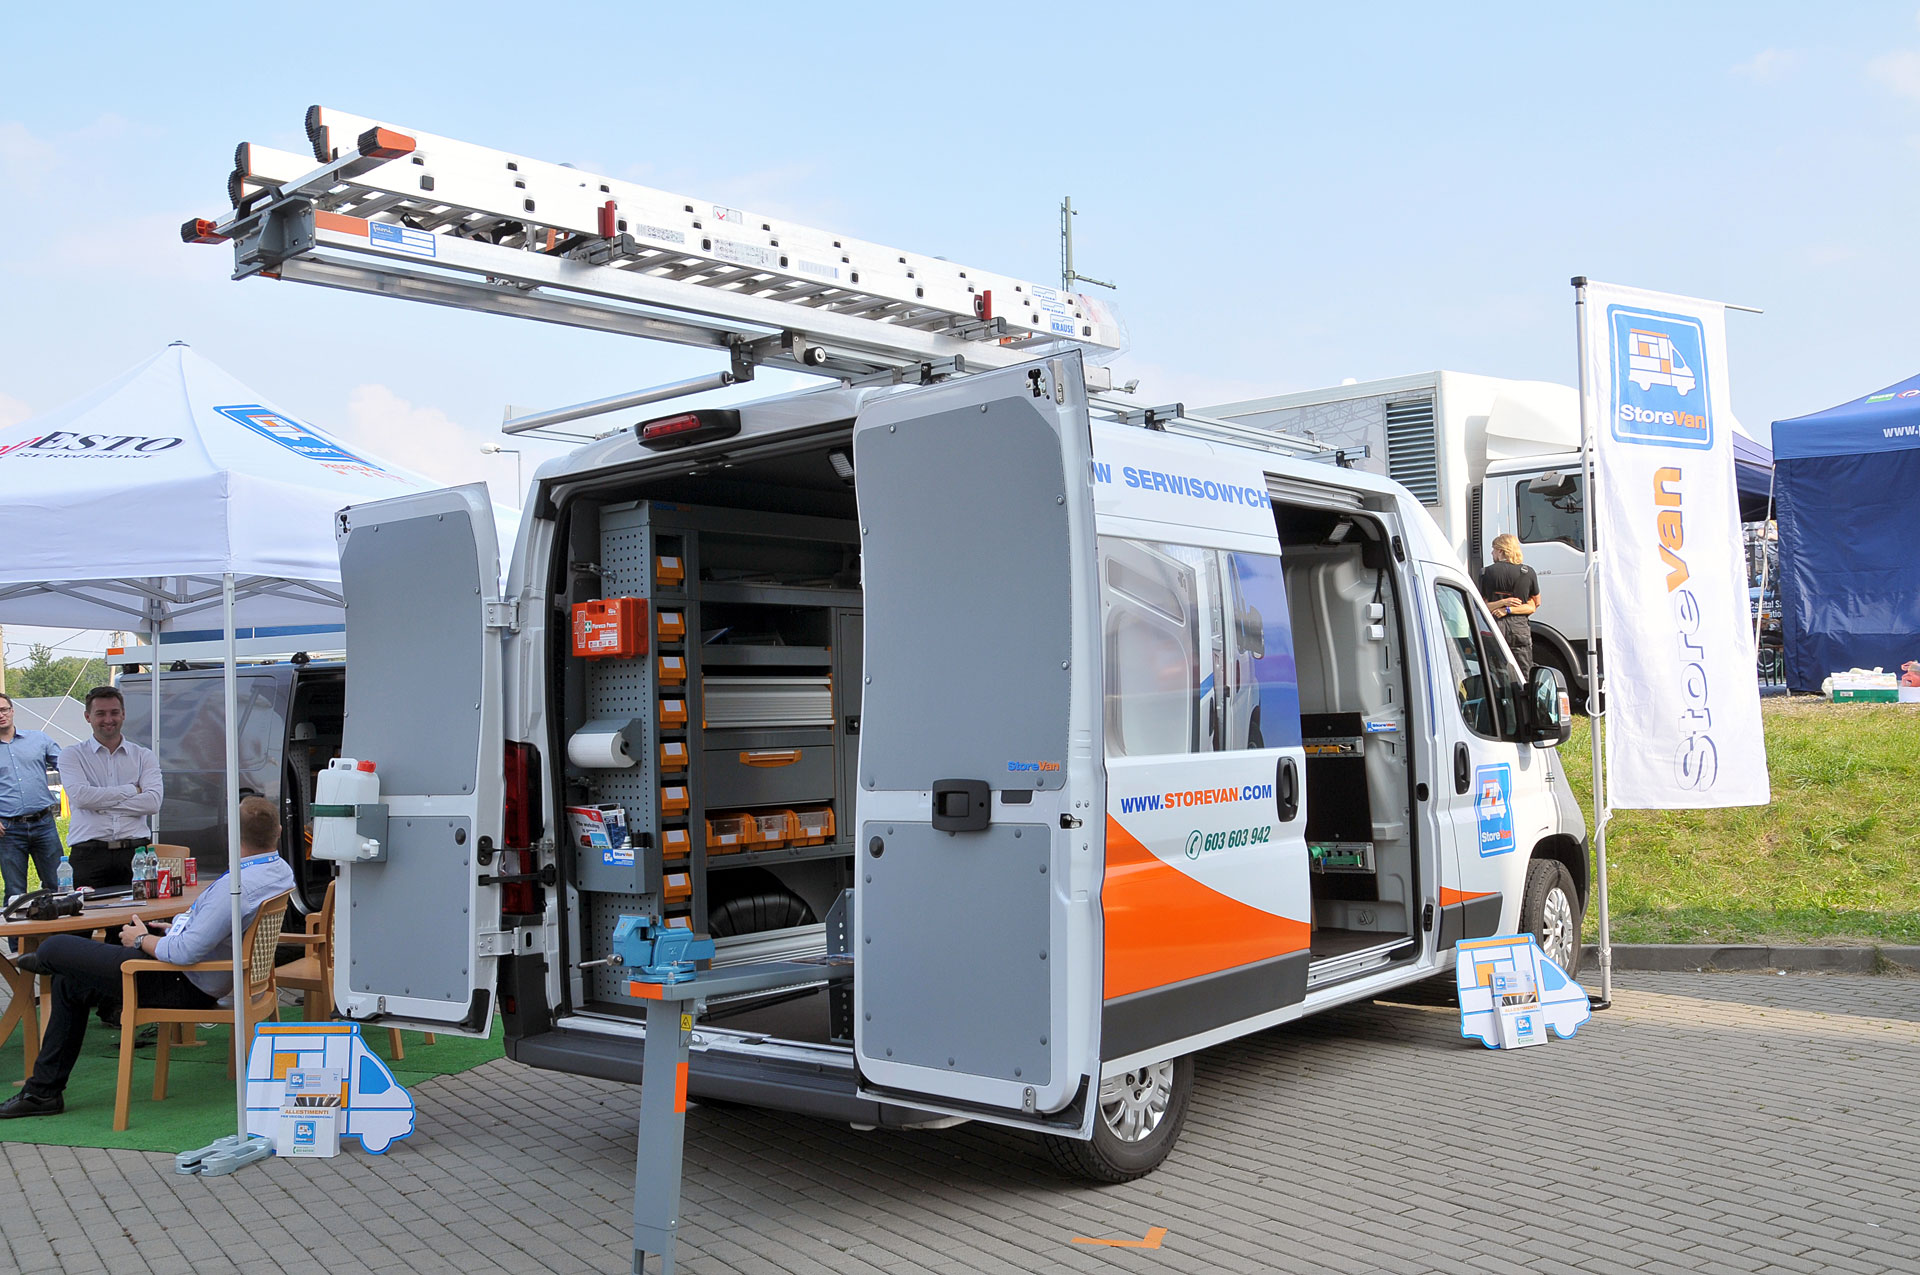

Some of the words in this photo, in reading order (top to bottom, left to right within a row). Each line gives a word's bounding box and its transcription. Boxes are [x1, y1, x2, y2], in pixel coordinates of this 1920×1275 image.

[1052, 322, 1074, 334] KRAUSE
[1620, 404, 1706, 429] StoreVan
[1123, 467, 1272, 509] SERWISOWYCH
[1008, 761, 1060, 771] StoreVan
[1121, 785, 1272, 813] WWW.STOREVAN.COM
[1204, 832, 1225, 851] 603
[1228, 829, 1248, 848] 603
[1251, 826, 1271, 844] 942
[1481, 829, 1512, 842] StoreVan
